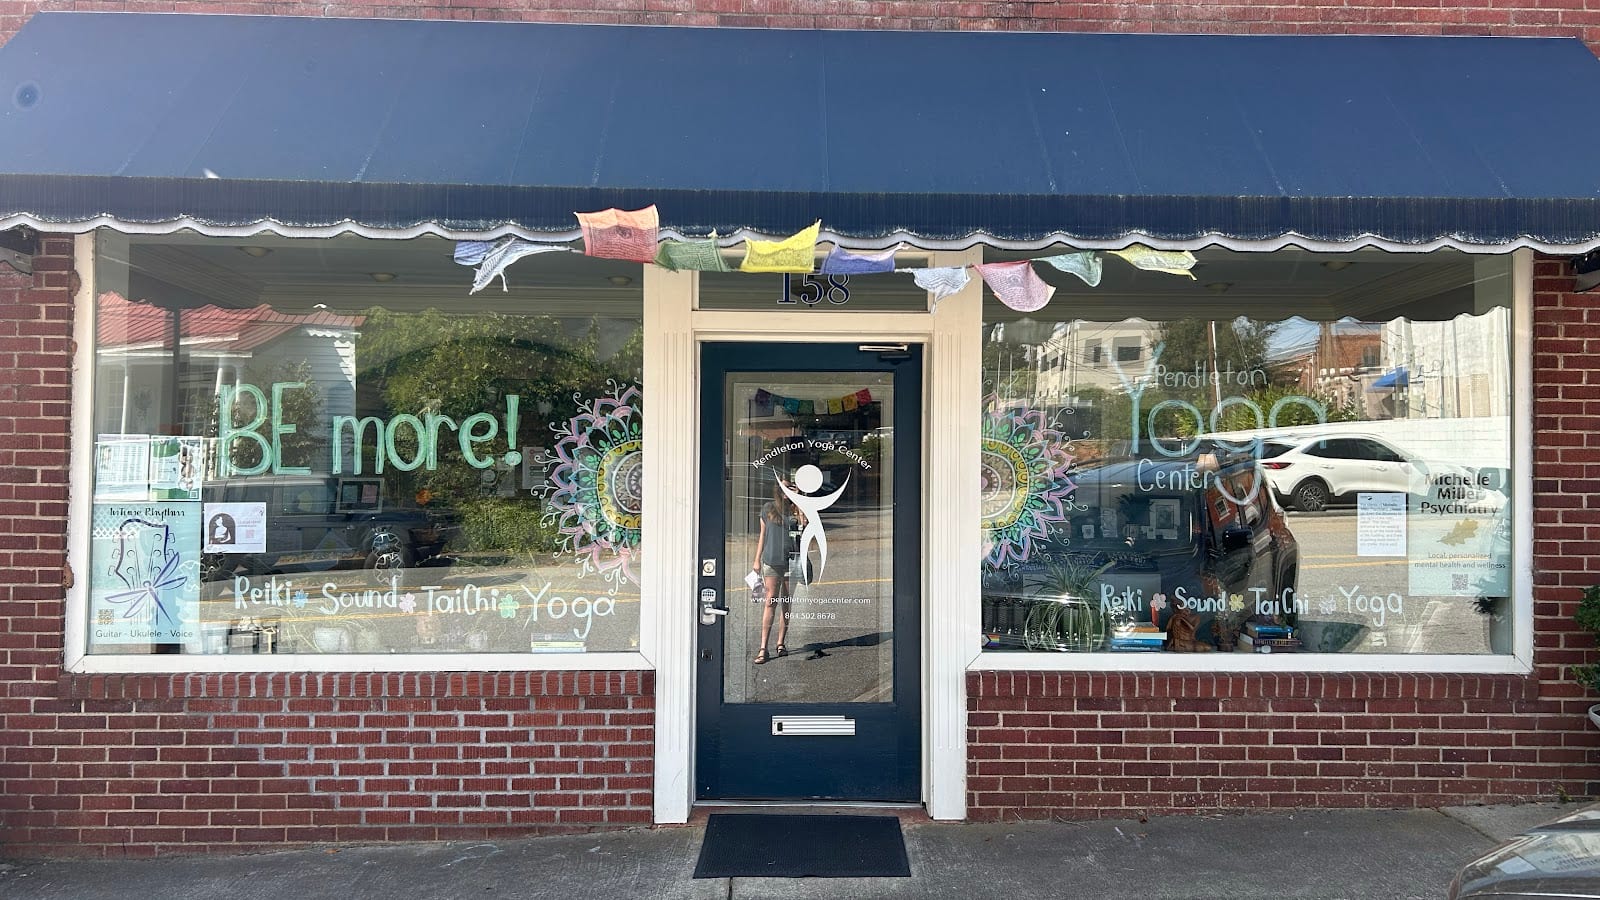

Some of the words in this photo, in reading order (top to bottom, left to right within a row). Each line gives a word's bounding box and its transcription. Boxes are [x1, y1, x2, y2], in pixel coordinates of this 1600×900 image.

[777, 271, 851, 305] 158
[1154, 360, 1267, 389] Pendleton
[218, 382, 311, 477] BE
[332, 395, 522, 475] more!
[1108, 341, 1328, 506] Yoga
[752, 441, 804, 469] Pendleton
[808, 439, 834, 451] Yoga
[838, 445, 872, 471] Center
[1138, 459, 1216, 491] Center
[1425, 472, 1490, 486] Michelle
[1437, 487, 1484, 500] Miller
[1421, 501, 1498, 517] Psychiatry
[1439, 561, 1461, 569] health
[234, 576, 292, 609] Reiki
[321, 577, 398, 615] Sound
[521, 582, 616, 639] Yoga
[751, 596, 871, 605] www.pendletonyogacenter.com
[1100, 583, 1143, 613] Reiki
[1175, 586, 1225, 612] Sound
[1341, 585, 1402, 626] Yoga
[95, 629, 122, 638] Guitar
[130, 629, 162, 638] Ukulele
[170, 629, 193, 638] Voice
